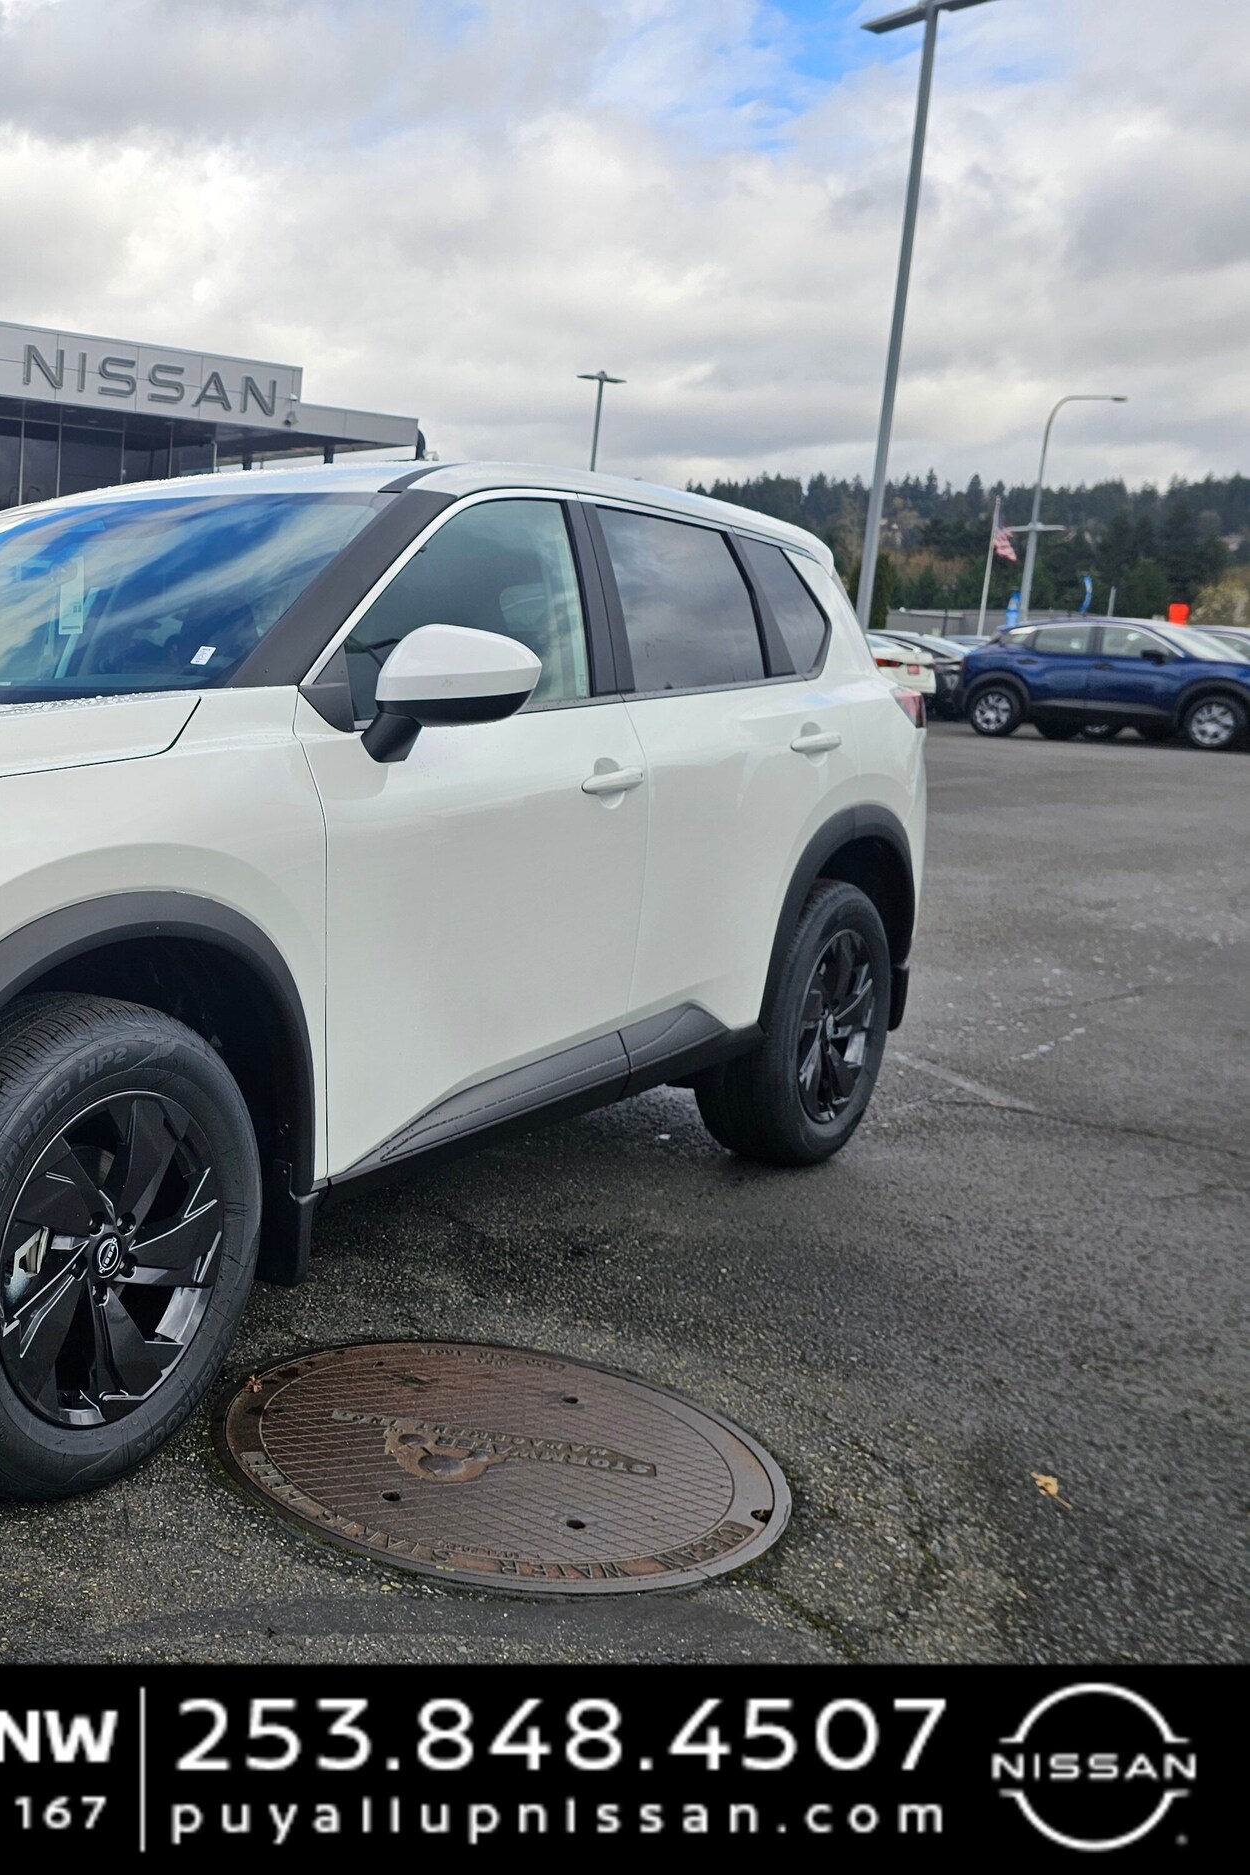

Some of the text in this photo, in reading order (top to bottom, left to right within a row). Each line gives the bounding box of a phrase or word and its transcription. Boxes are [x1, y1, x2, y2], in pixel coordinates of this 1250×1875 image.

[23, 344, 277, 416] NISSAN
[78, 1047, 127, 1083] HP2
[500, 1558, 631, 1580] WATER
[653, 1526, 745, 1572] CLEAN
